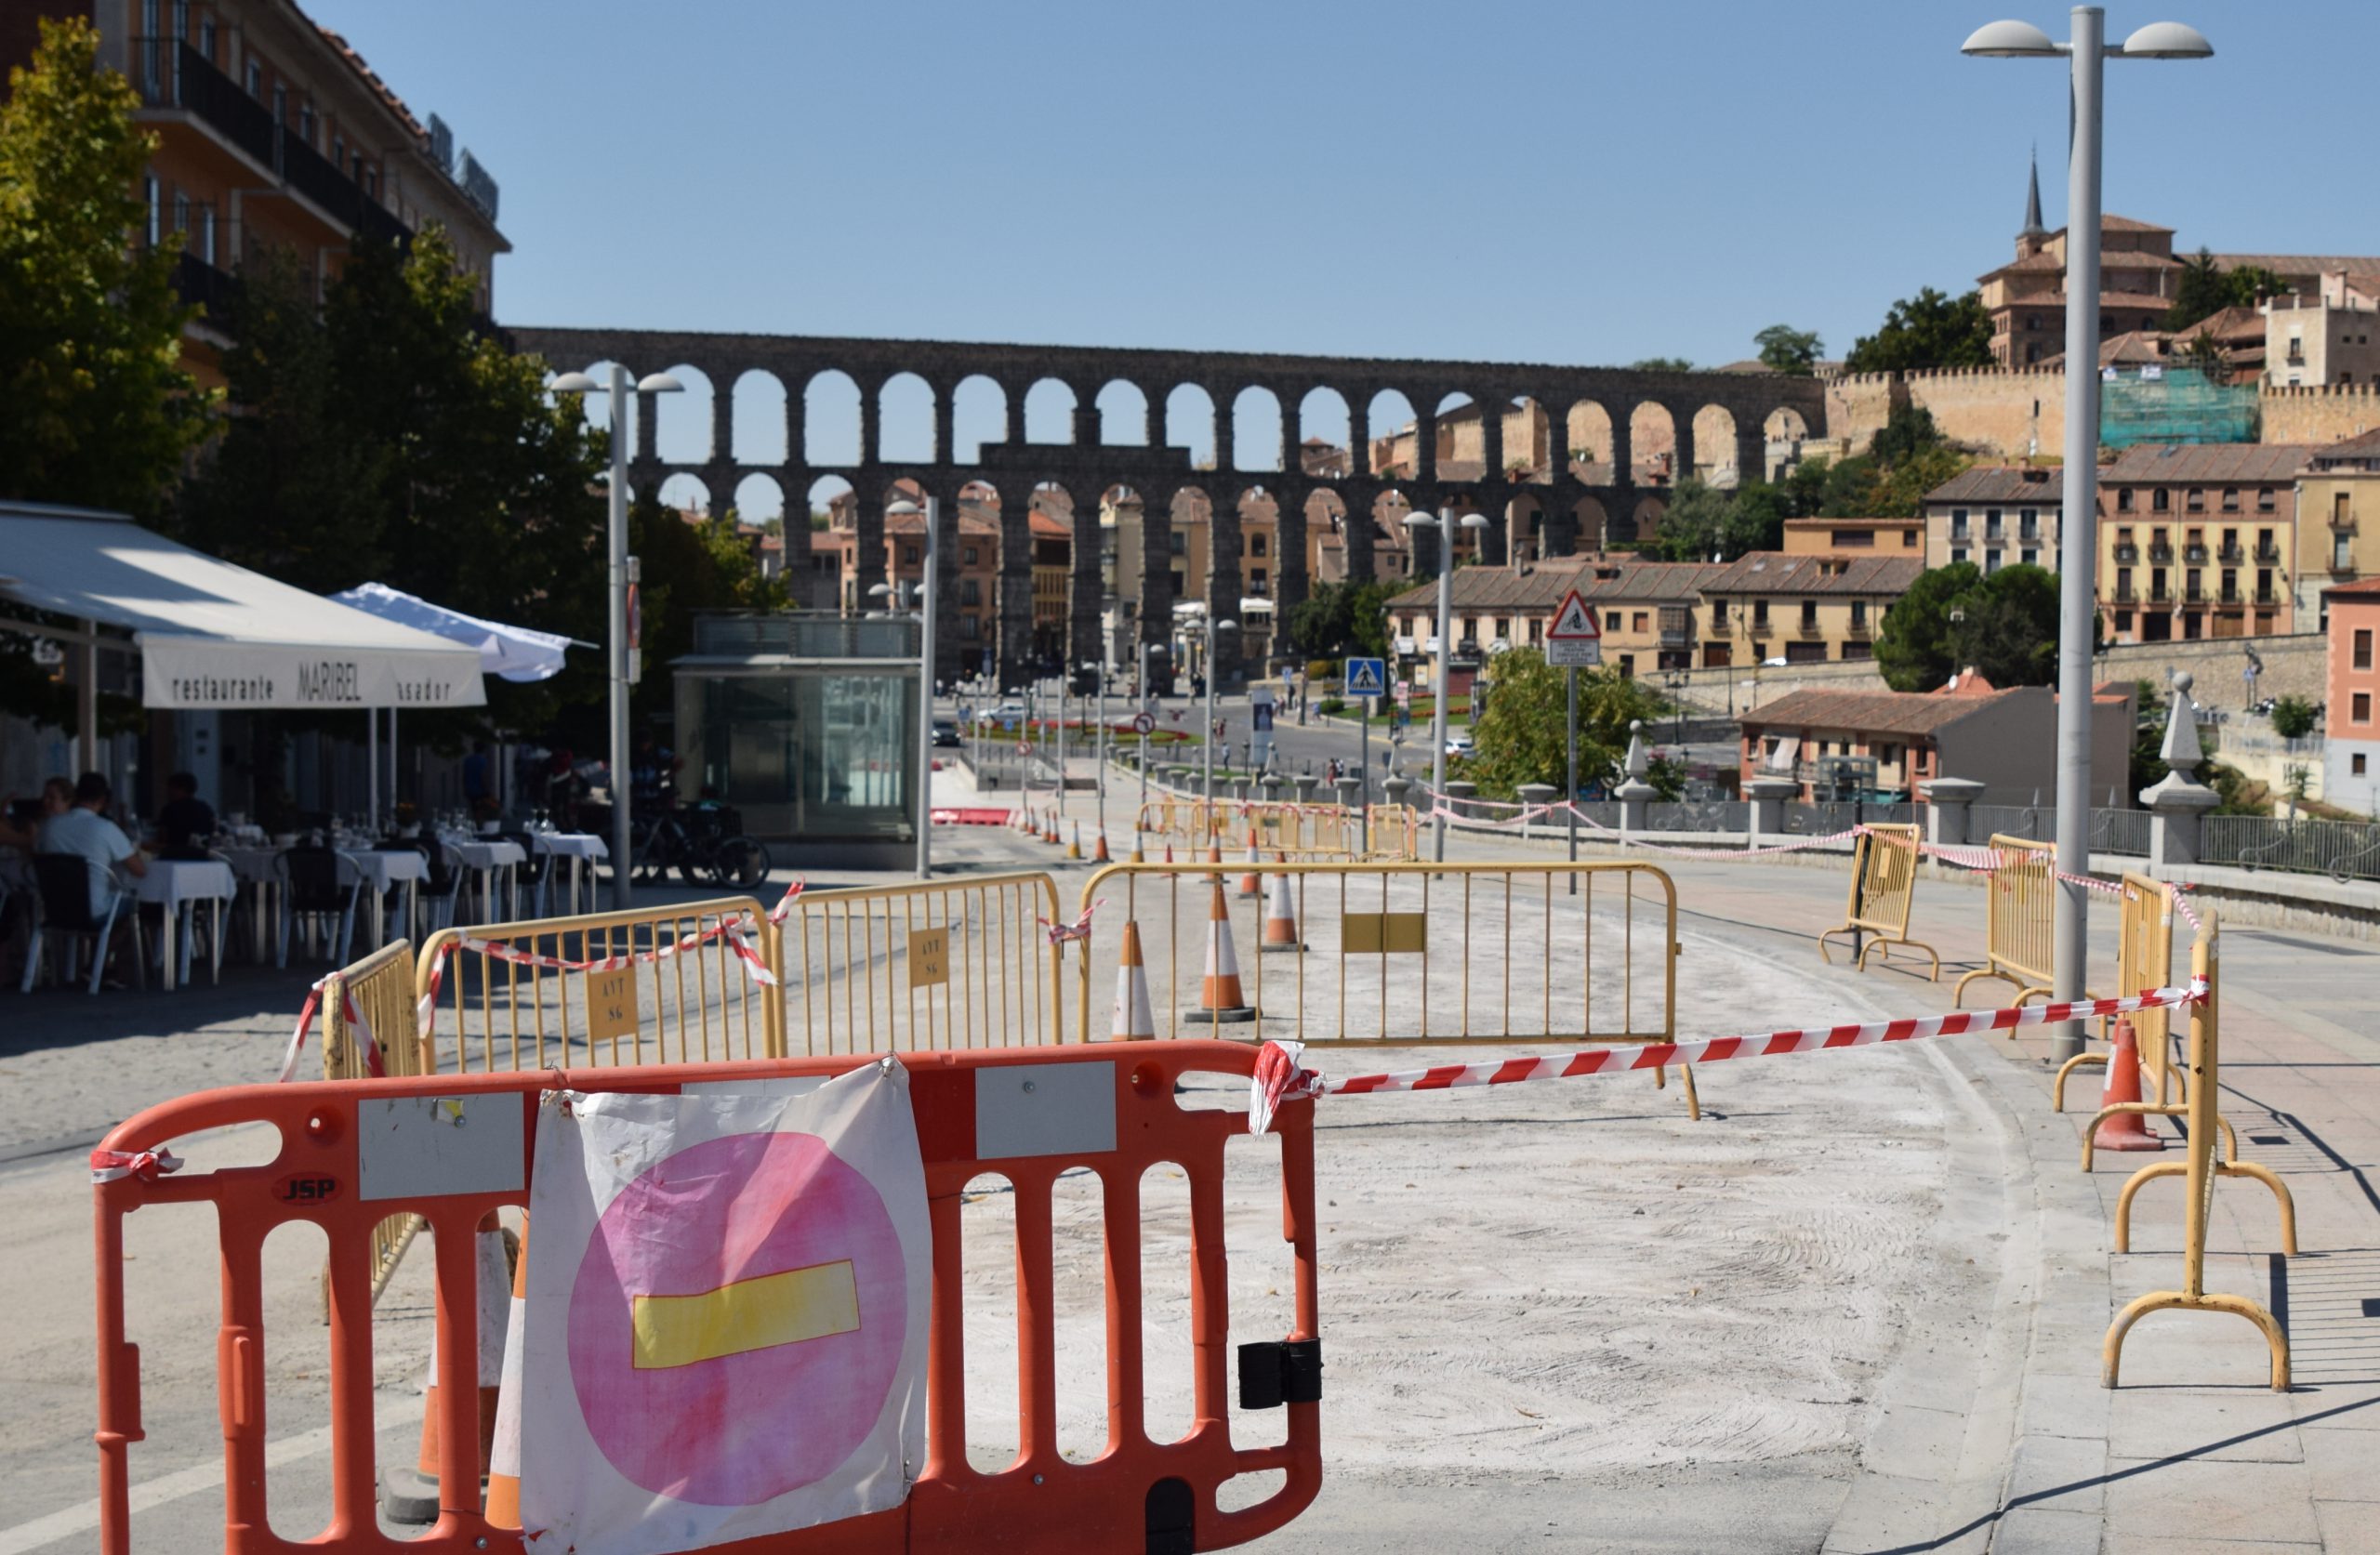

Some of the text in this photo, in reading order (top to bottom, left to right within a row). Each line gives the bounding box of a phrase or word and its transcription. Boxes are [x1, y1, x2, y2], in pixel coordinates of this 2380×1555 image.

[173, 675, 273, 701] restaurante
[298, 661, 361, 701] MARIBEL
[282, 1179, 336, 1200] JSP
